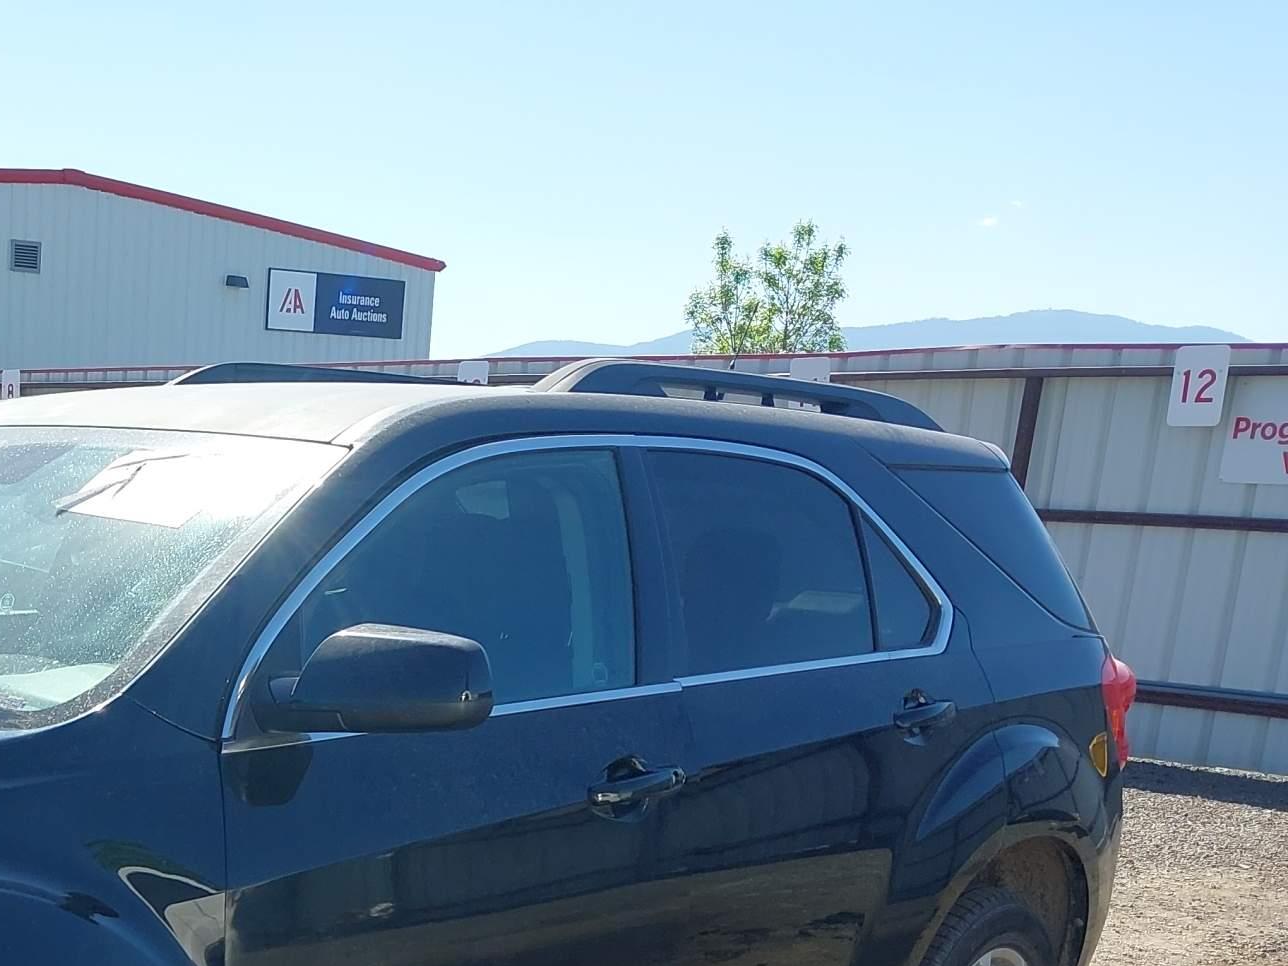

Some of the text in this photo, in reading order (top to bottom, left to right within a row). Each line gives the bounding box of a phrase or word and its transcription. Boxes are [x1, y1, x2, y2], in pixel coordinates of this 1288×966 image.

[339, 291, 380, 307] Insurance
[330, 306, 387, 322] Auto Auctions
[1181, 368, 1217, 403] 12
